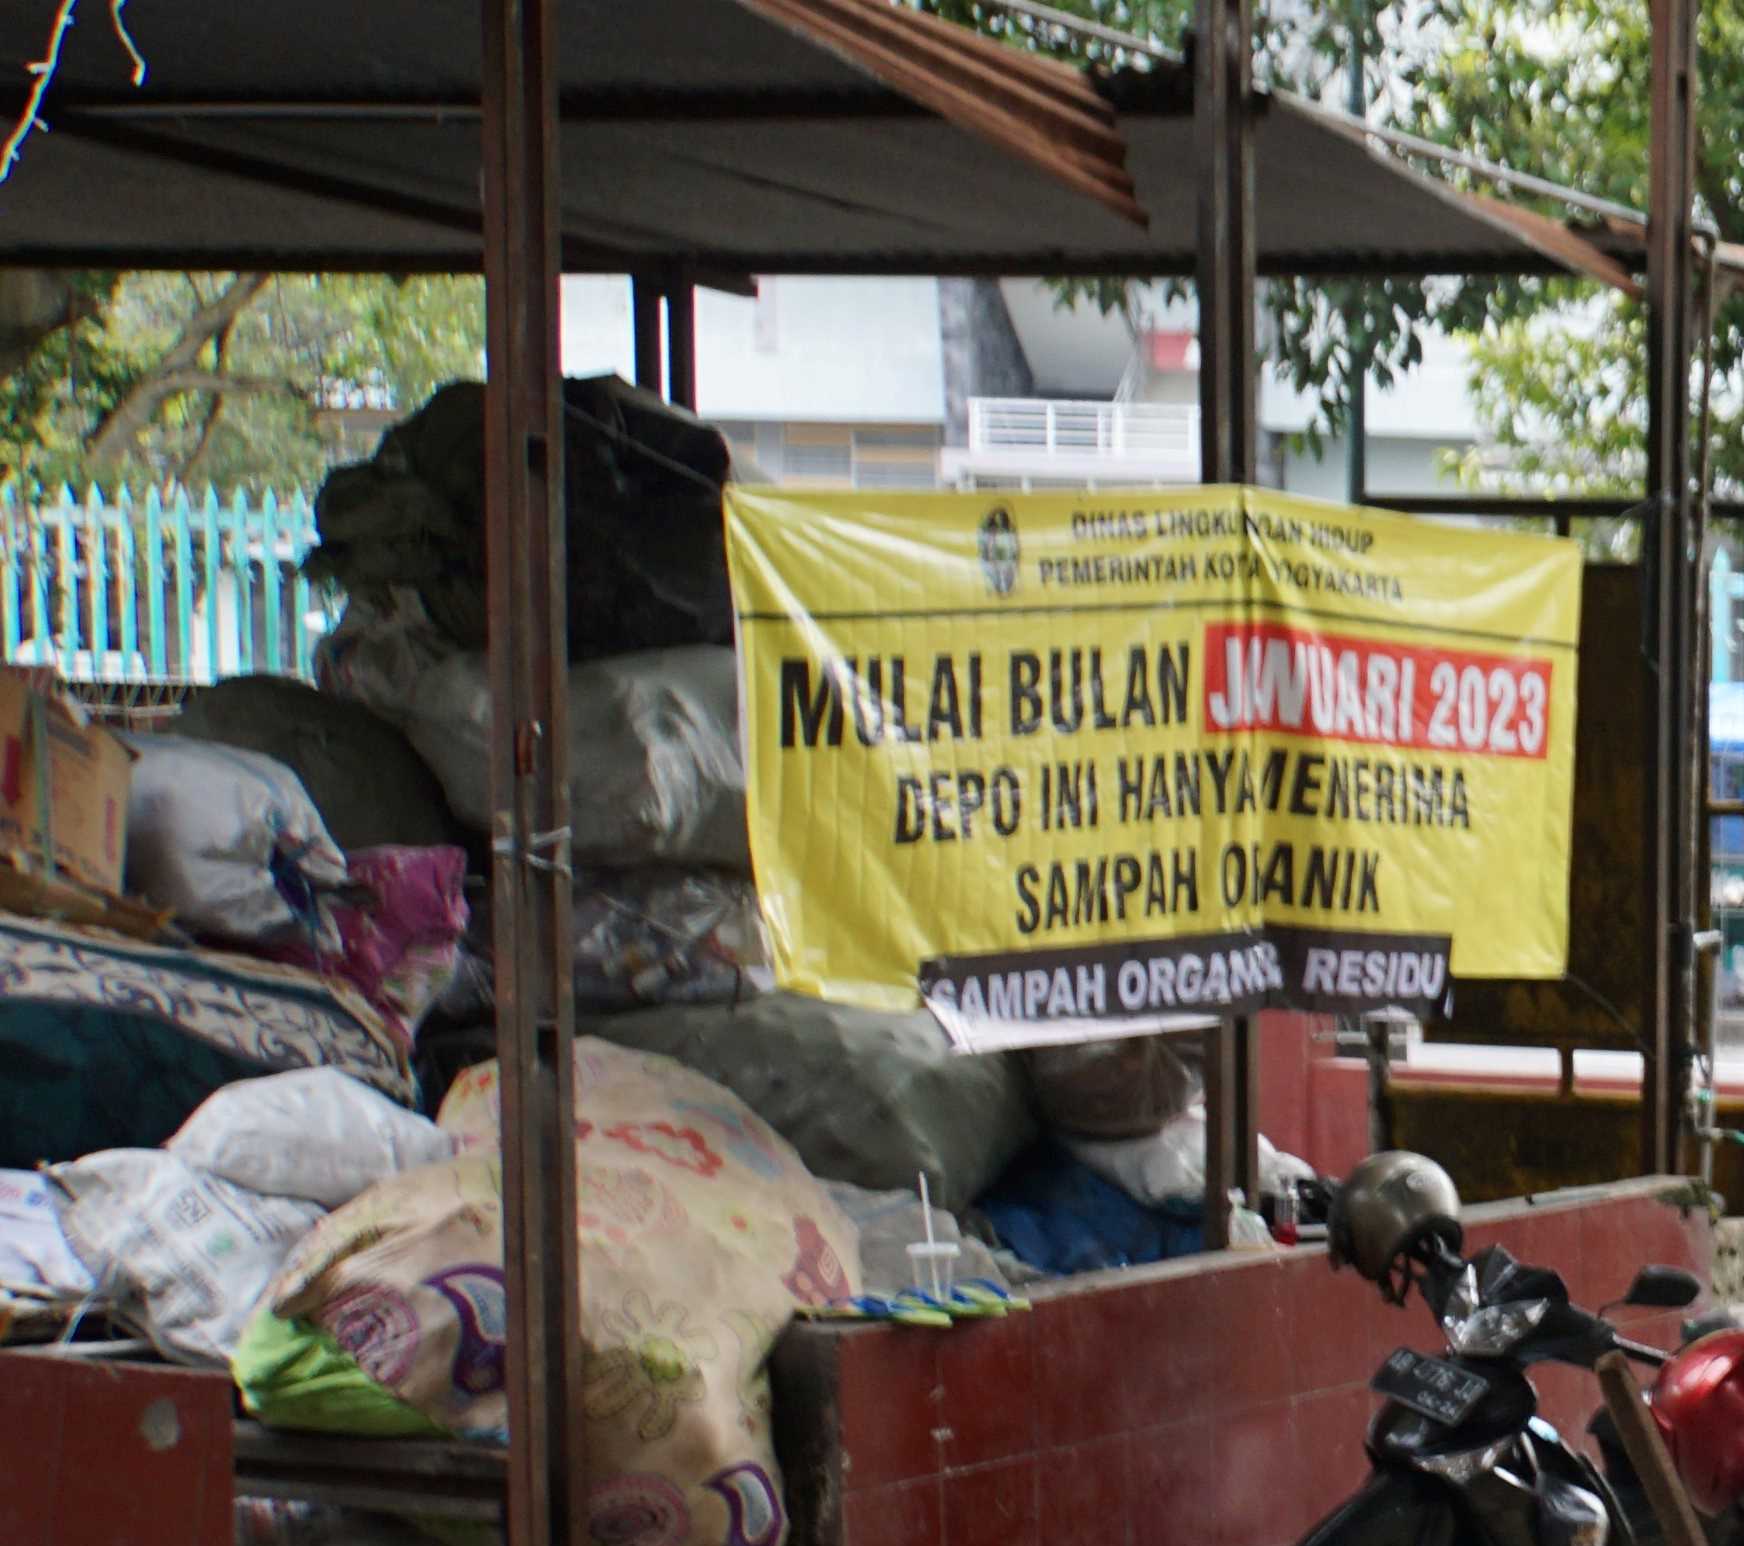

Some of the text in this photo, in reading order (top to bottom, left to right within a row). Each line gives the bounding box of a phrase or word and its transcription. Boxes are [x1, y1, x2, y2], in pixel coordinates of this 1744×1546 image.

[1071, 510, 1148, 540] DINAS
[1039, 549, 1197, 585] PEMERINTAH
[1204, 550, 1261, 579] KOTA
[780, 651, 983, 748] MULAI
[1009, 641, 1190, 737] BULAN
[1427, 661, 1546, 755] 2023
[894, 768, 1021, 844] DEPO
[1040, 760, 1099, 831] INI
[1118, 748, 1257, 823] HANYA
[1014, 847, 1200, 935] SAMPAH
[1301, 946, 1446, 1000] RESIDU
